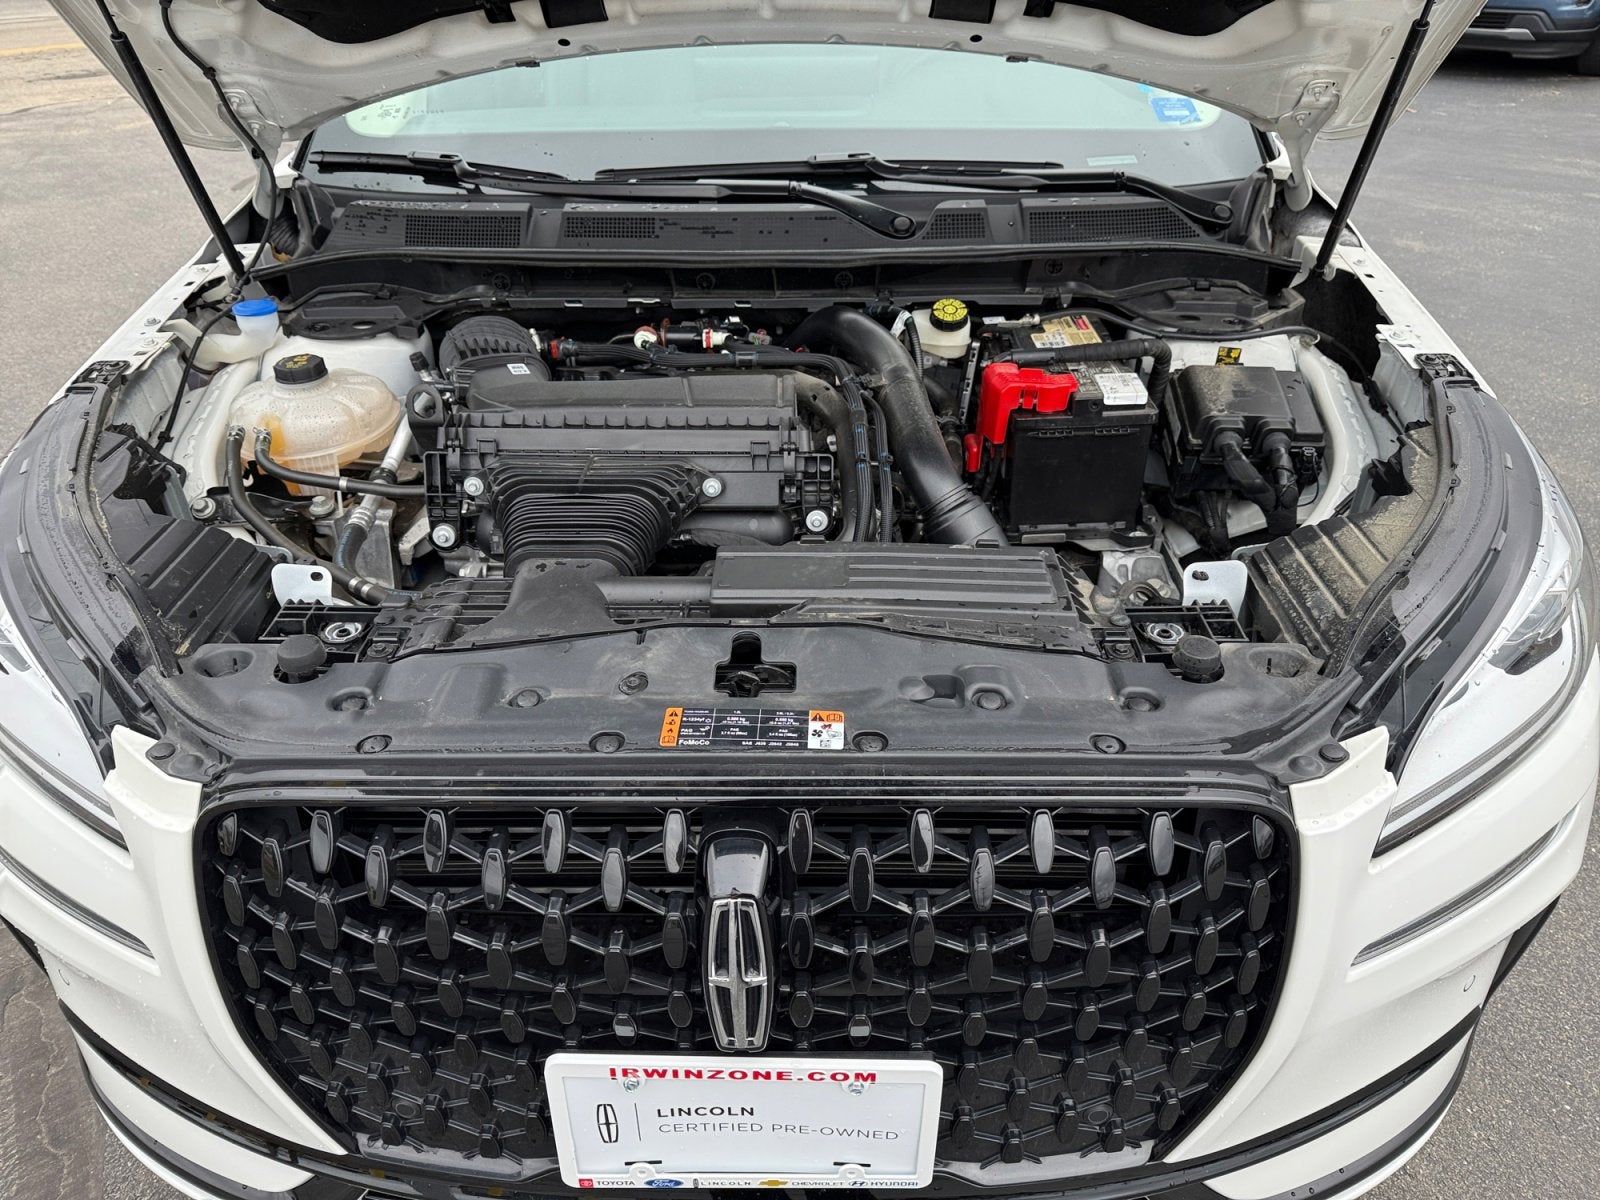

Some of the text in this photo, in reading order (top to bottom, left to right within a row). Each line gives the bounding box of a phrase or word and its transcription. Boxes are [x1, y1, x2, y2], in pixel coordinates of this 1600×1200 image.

[609, 1067, 877, 1082] IRWINZONE.COM
[657, 1106, 754, 1118] LINCOLN
[658, 1123, 899, 1140] CERTIFIED PRE-OWNED
